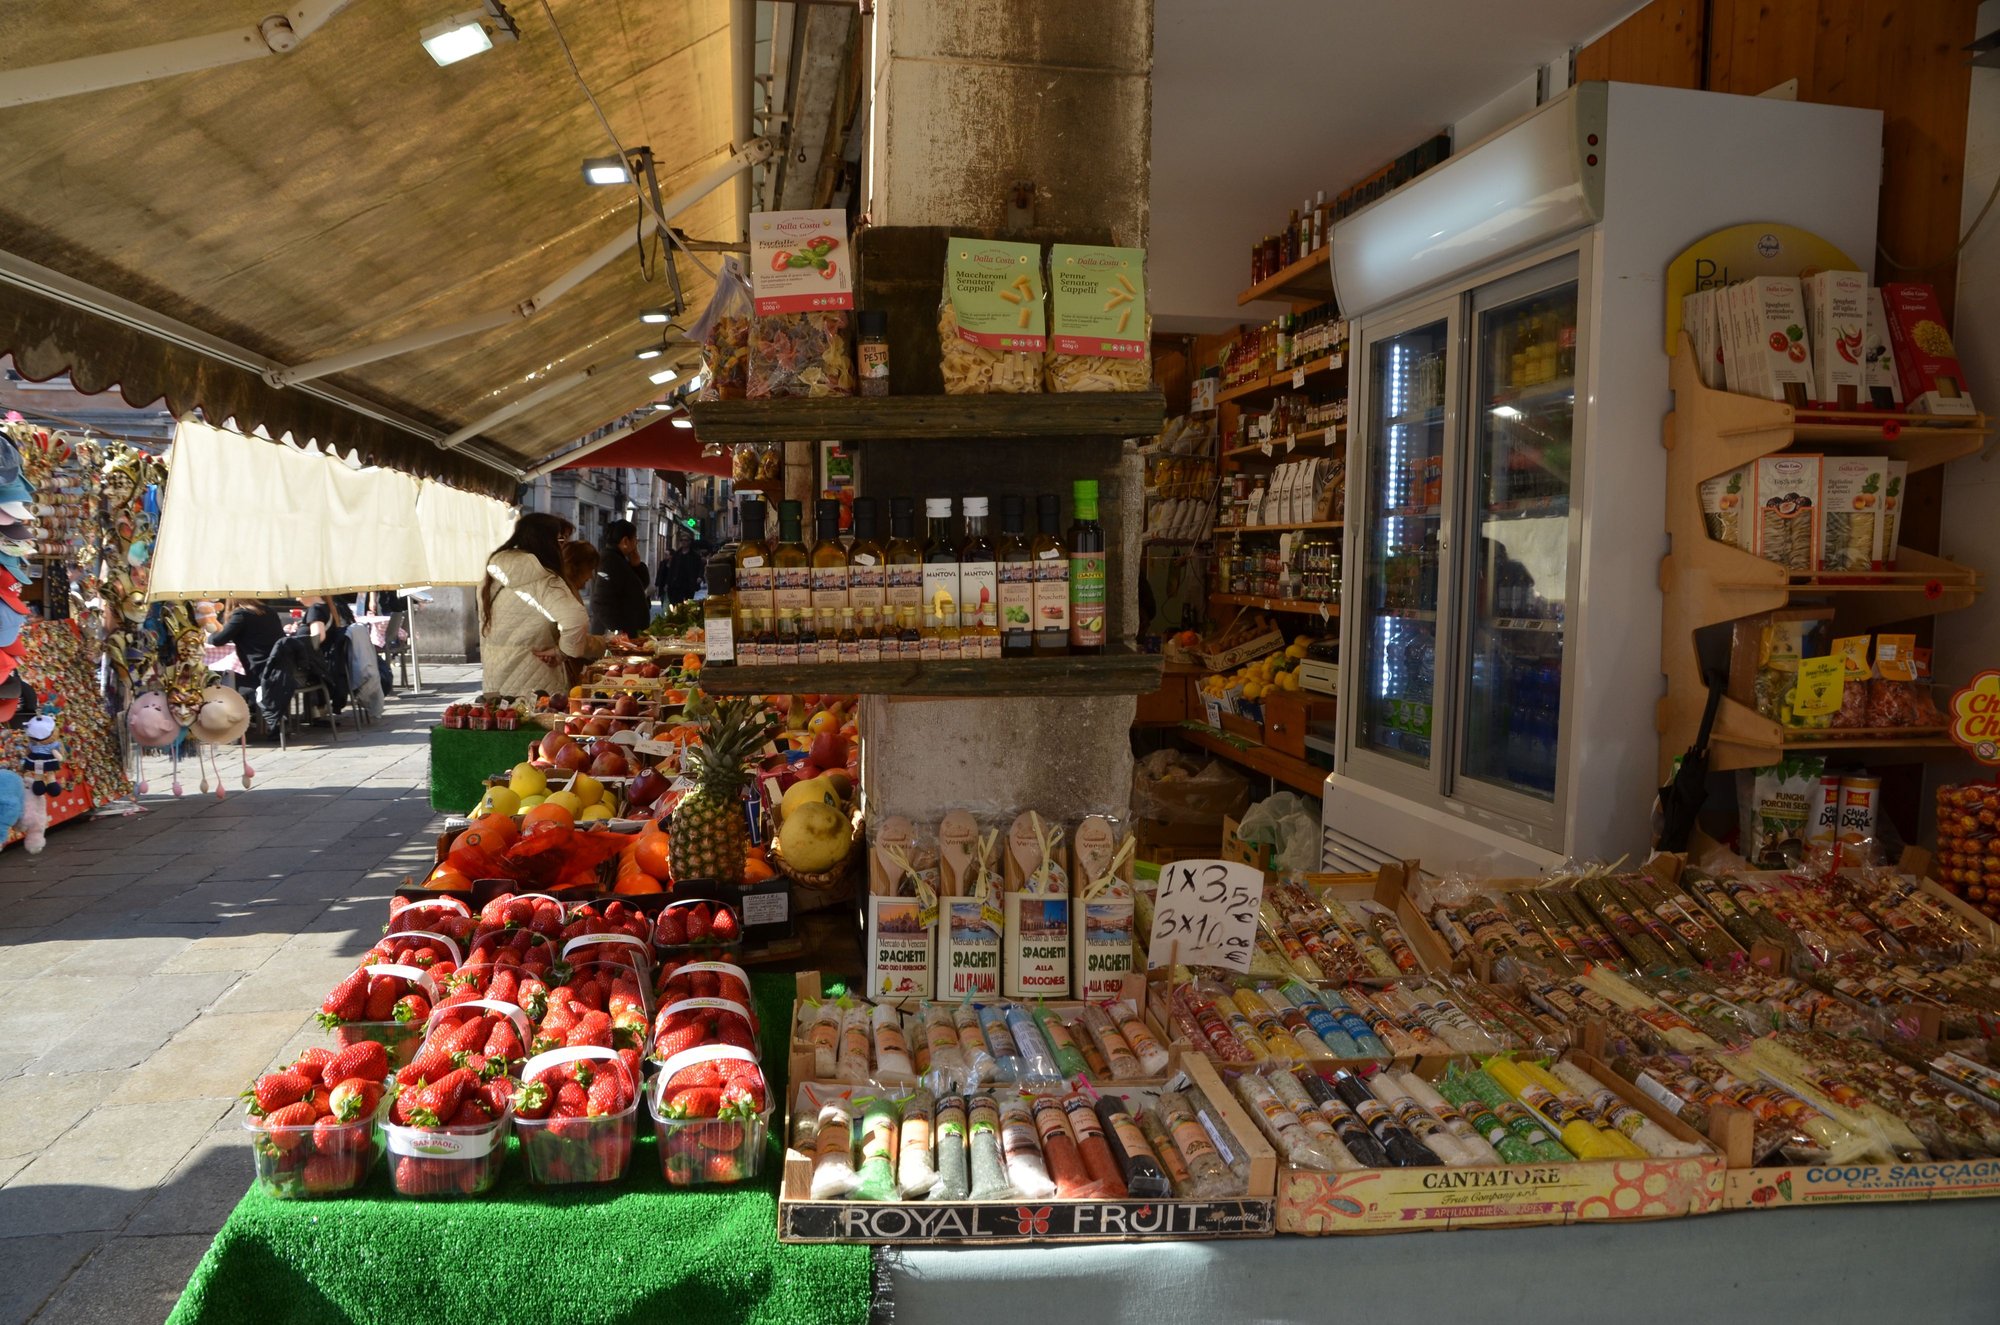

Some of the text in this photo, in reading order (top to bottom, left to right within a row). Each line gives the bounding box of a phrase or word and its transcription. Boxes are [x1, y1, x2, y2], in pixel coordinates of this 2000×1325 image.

[974, 254, 1015, 264] Dalla Costa
[956, 271, 1007, 280] Maccheroni
[1060, 272, 1086, 280] Penne
[956, 278, 995, 286] Senatore
[1060, 279, 1099, 287] Senatore
[957, 284, 994, 293] Cappelli
[1061, 285, 1097, 295] Cappelli
[864, 352, 887, 362] PESTO
[1003, 594, 1030, 602] Basilico
[1776, 792, 1805, 801] FUNGHI
[1761, 799, 1792, 809] PORCINI
[1161, 865, 1175, 898] 1
[1156, 908, 1176, 939] 3
[879, 939, 900, 948] Mercato
[906, 940, 926, 948] Venezia
[879, 949, 926, 963] SPAGHETTI
[1022, 946, 1066, 958] SPAGHETTI
[953, 951, 997, 968] SPAGHETTI
[1088, 954, 1131, 972] SPAGHETTI
[1022, 976, 1065, 985] BOLOGNESE
[1089, 979, 1101, 992] ALLA
[413, 1139, 460, 1150] SAN PAOLO
[1422, 1167, 1561, 1190] CANTATORE
[1806, 1167, 1881, 1183] COOP.
[1847, 1179, 1936, 1188] Cavallino
[1441, 1194, 1469, 1205] Fruit
[1471, 1190, 1515, 1204] Company
[1434, 1206, 1476, 1218] APULIAN
[846, 1203, 1209, 1237] ROYAL FRUIT
